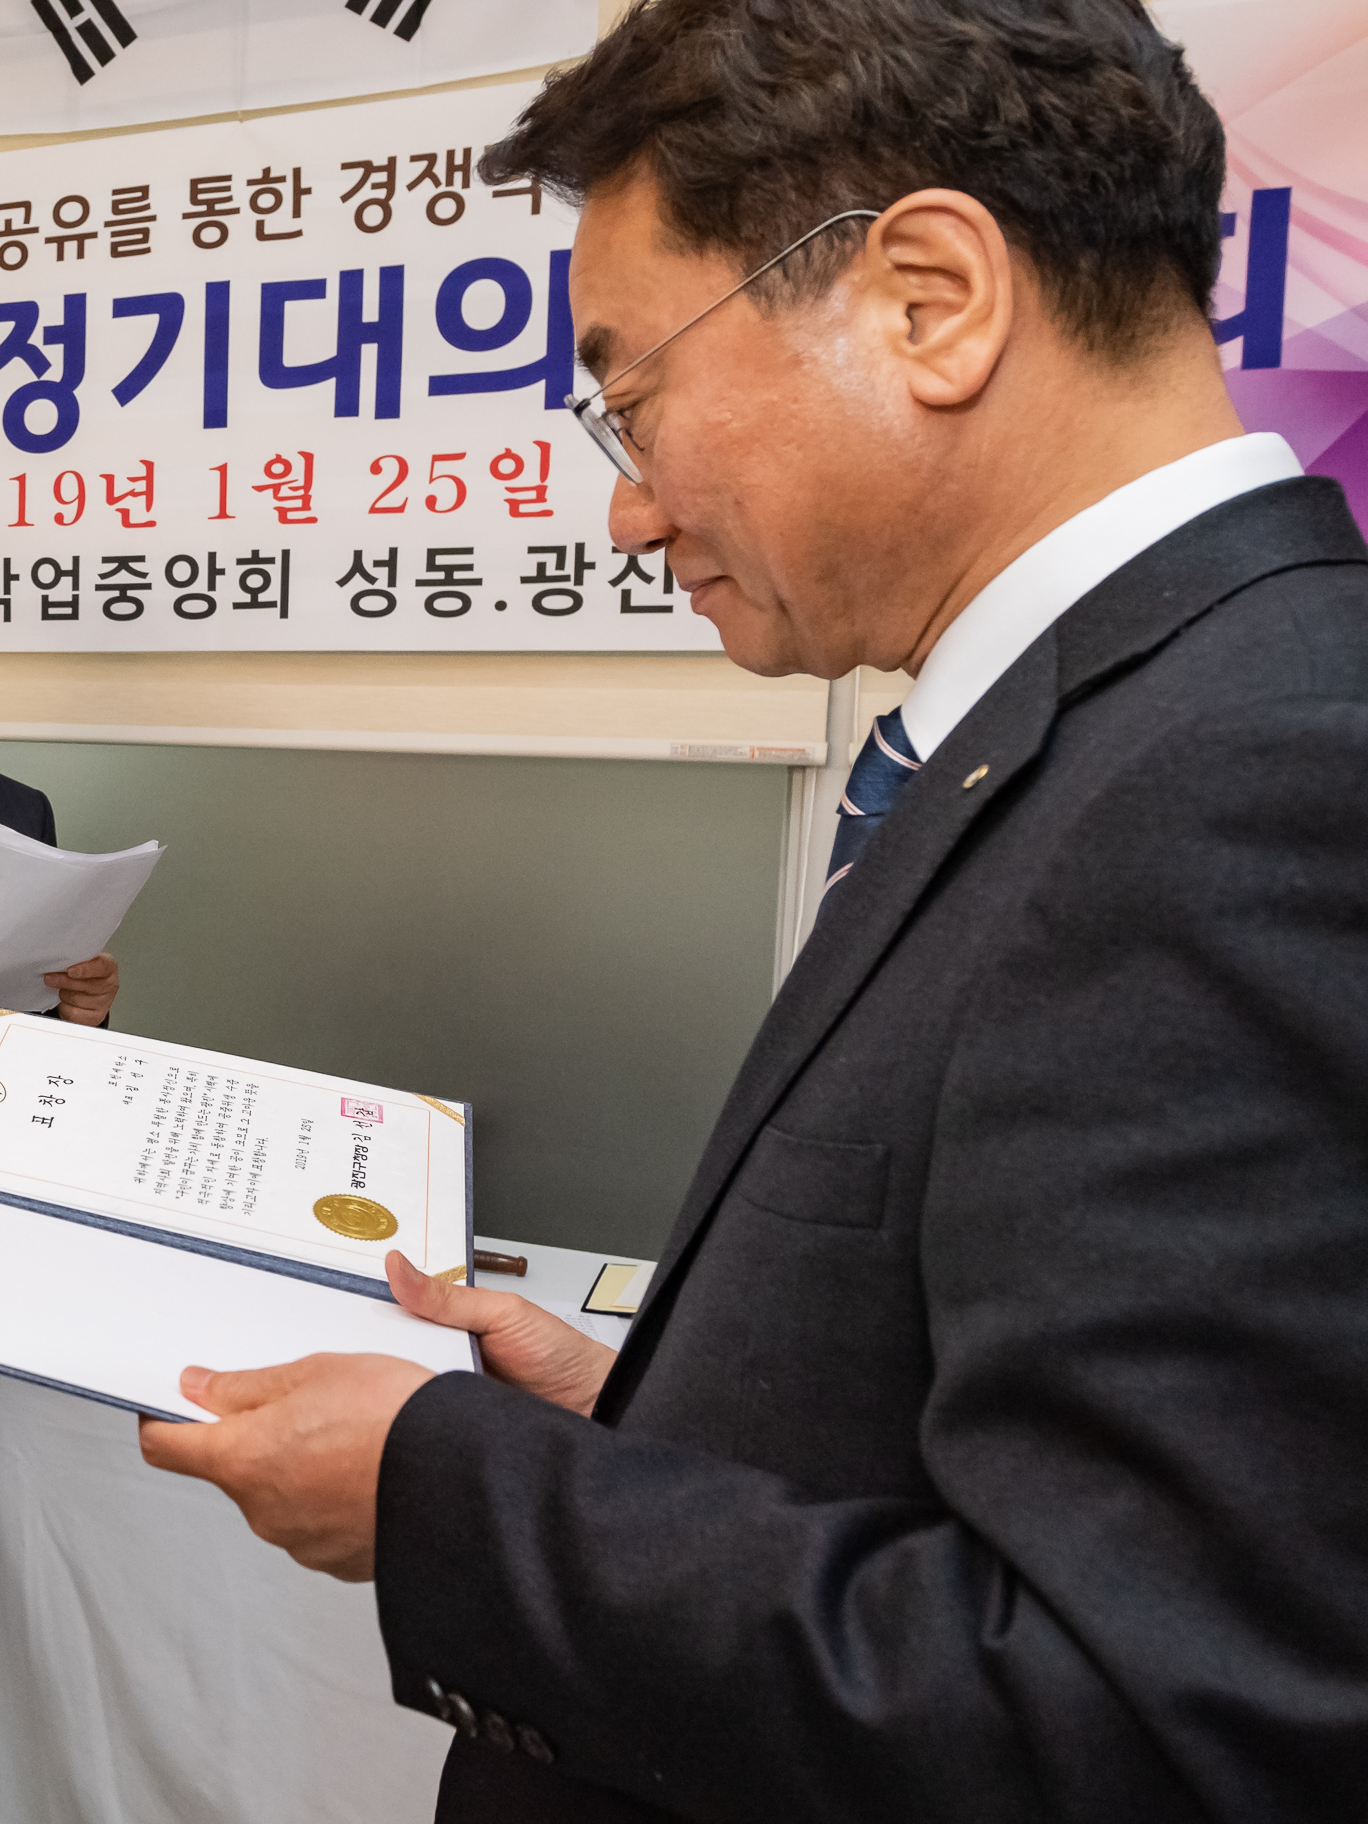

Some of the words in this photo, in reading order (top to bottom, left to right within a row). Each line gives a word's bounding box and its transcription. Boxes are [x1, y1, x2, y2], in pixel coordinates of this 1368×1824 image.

[182, 166, 312, 250] 통한
[208, 450, 319, 525] 1월
[368, 439, 554, 519] 25일
[146, 1131, 160, 1145] 평소
[158, 1066, 180, 1105] 봉사정신으로
[300, 1118, 314, 1132] 25일
[153, 1168, 172, 1195] 지역사회
[173, 1105, 190, 1130] 노력하여
[294, 1148, 310, 1170] 2019년
[350, 1144, 369, 1189] 광진구청장
[241, 1187, 259, 1216] 기리고자
